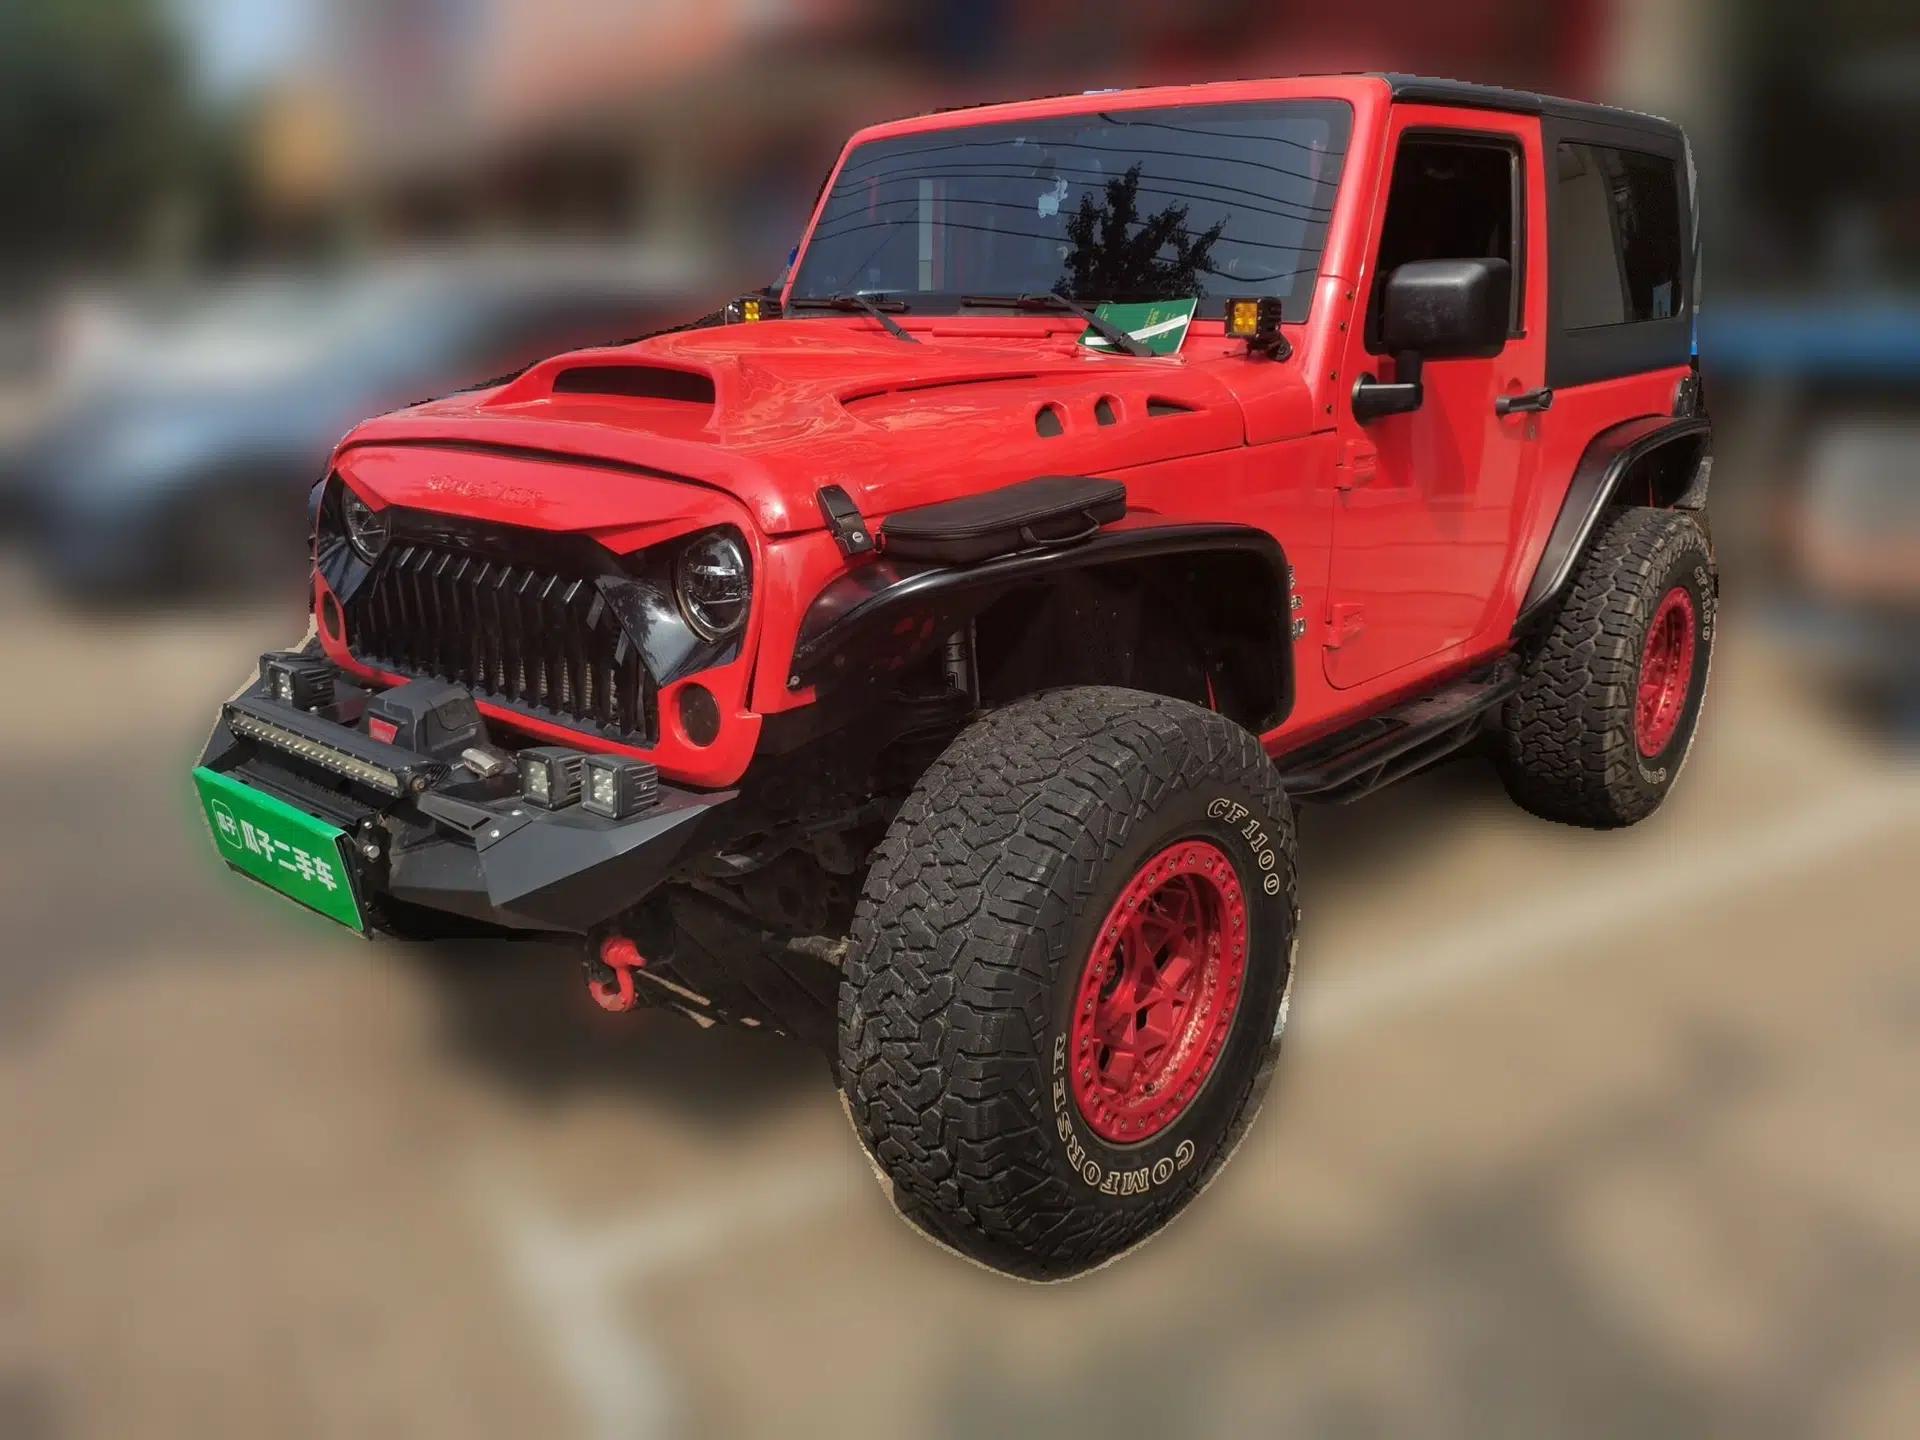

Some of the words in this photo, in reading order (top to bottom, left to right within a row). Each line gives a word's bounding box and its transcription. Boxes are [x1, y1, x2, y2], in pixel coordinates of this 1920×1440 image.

[240, 819, 337, 891] 瓜子二手车
[1207, 798, 1280, 895] CF1100
[1053, 1032, 1195, 1196] COMFORSER
